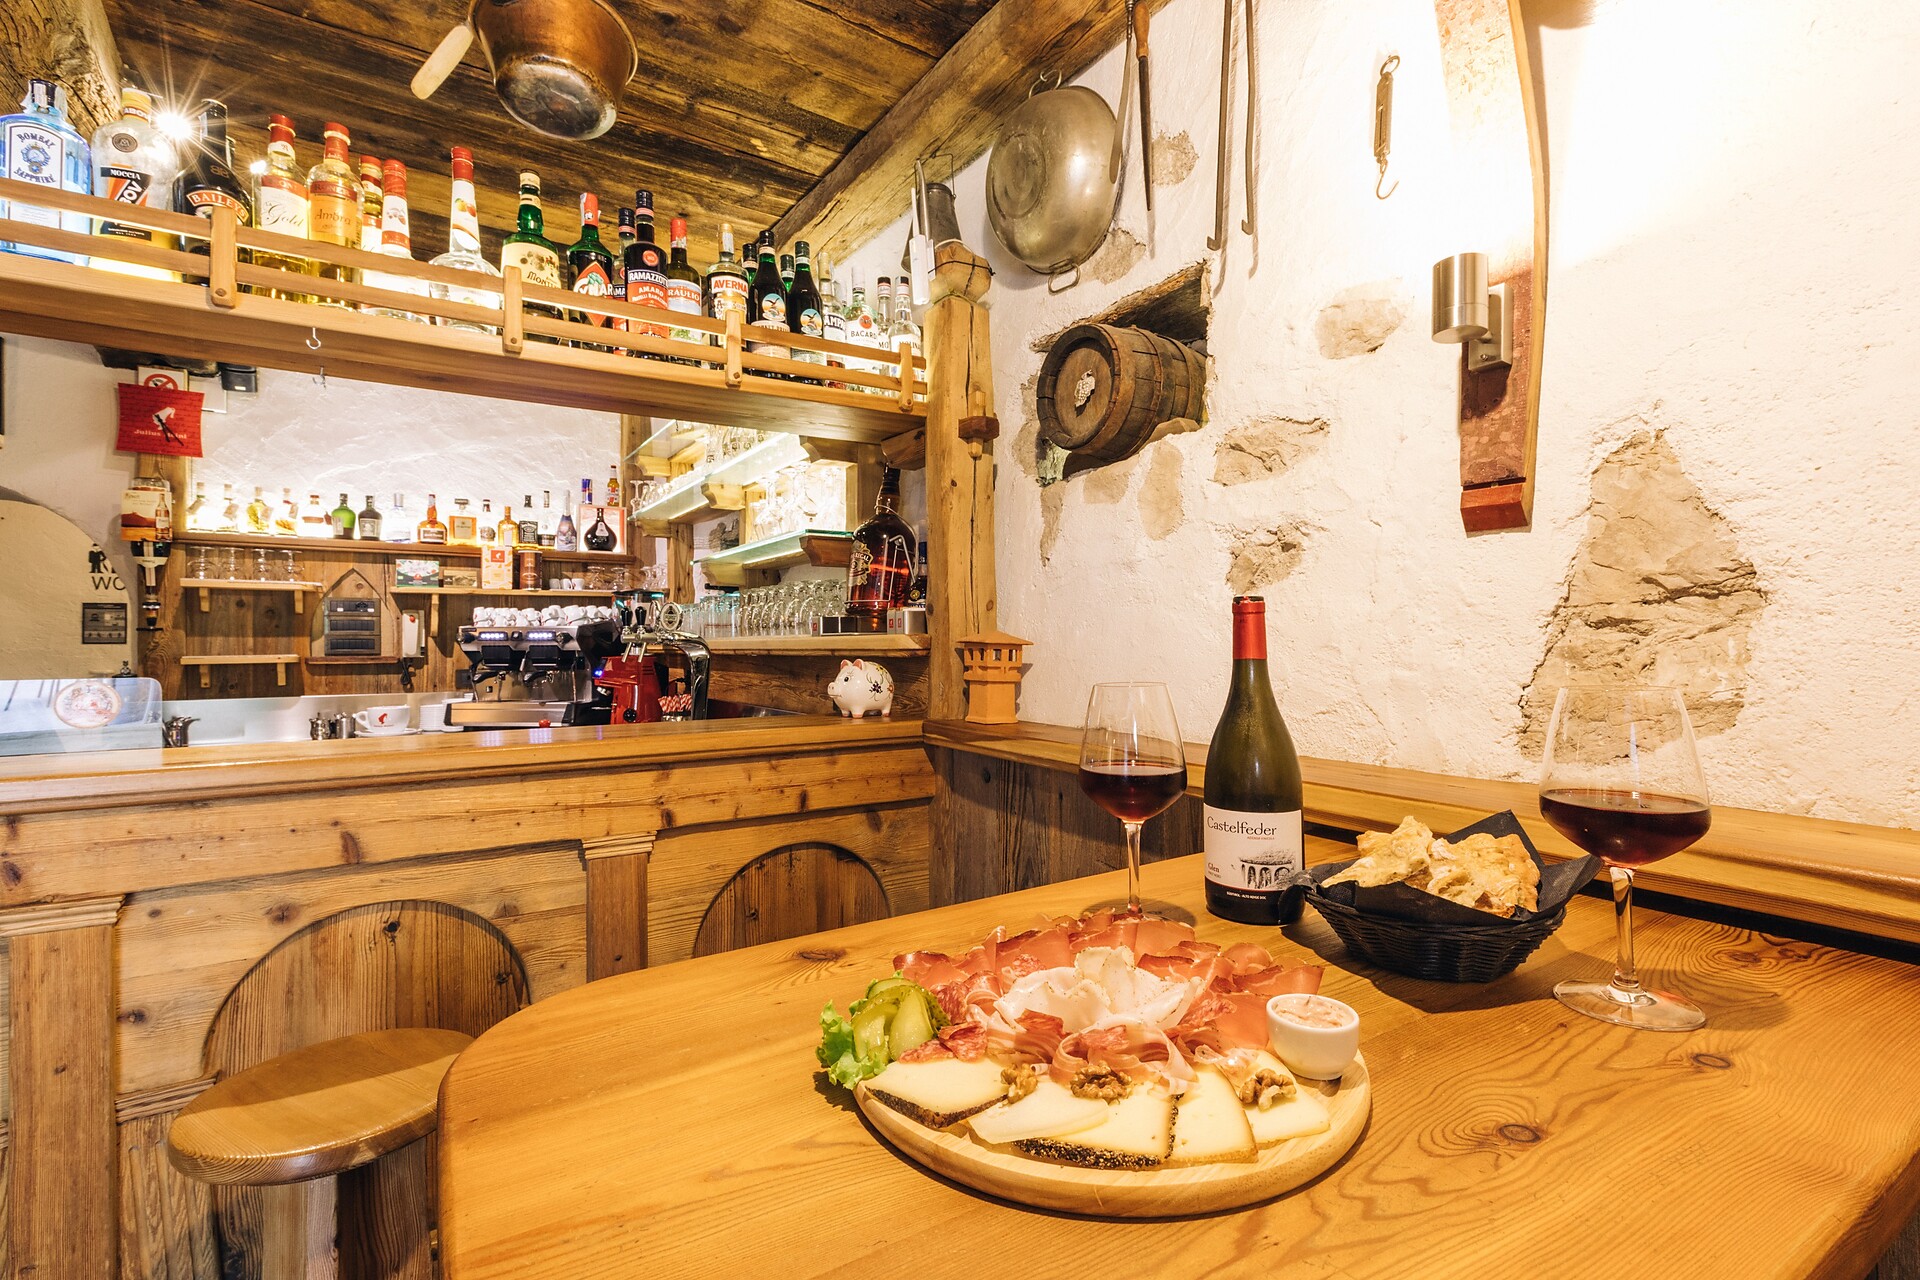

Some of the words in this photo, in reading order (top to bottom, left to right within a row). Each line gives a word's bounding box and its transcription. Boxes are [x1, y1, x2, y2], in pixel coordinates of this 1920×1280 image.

[16, 132, 56, 149] BOMBAY
[13, 167, 56, 184] SAPPHIRE
[110, 168, 141, 180] MOCCIA
[191, 194, 246, 218] BAILEYS
[314, 208, 352, 226] Ambra
[638, 285, 664, 298] AMARO
[713, 279, 749, 293] AVERNA
[667, 289, 700, 301] RAULIO
[850, 330, 878, 340] BACARD
[92, 575, 126, 590] WC
[1206, 816, 1277, 836] Castelfeder
[1207, 862, 1220, 873] Glen
